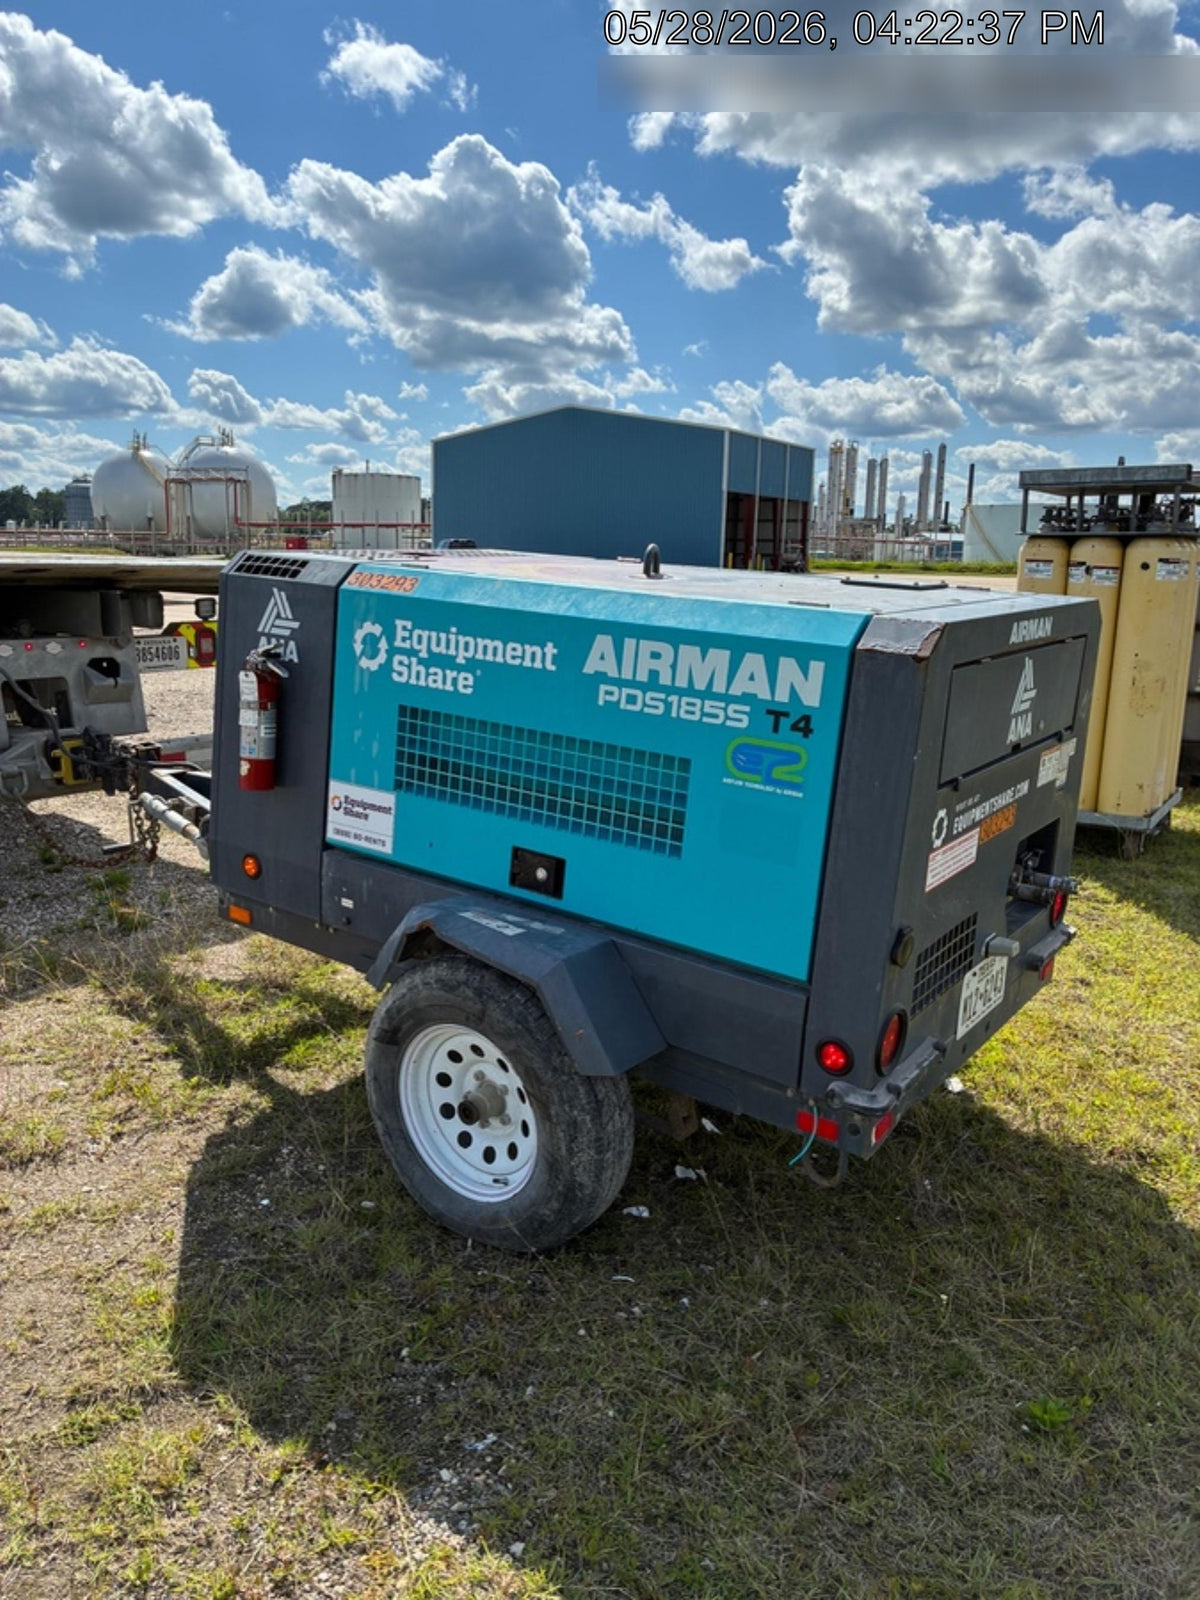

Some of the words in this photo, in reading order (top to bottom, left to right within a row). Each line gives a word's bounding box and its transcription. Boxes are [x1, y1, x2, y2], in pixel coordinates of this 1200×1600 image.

[394, 618, 558, 671] Equipment
[1008, 616, 1054, 645] AIRMAN
[391, 654, 476, 695] Share
[582, 633, 825, 708] AIRMAN
[597, 684, 751, 729] PDS185S
[765, 708, 815, 739] T4
[1006, 711, 1033, 744] ANA
[343, 807, 369, 821] Share
[344, 795, 392, 815] Equipment
